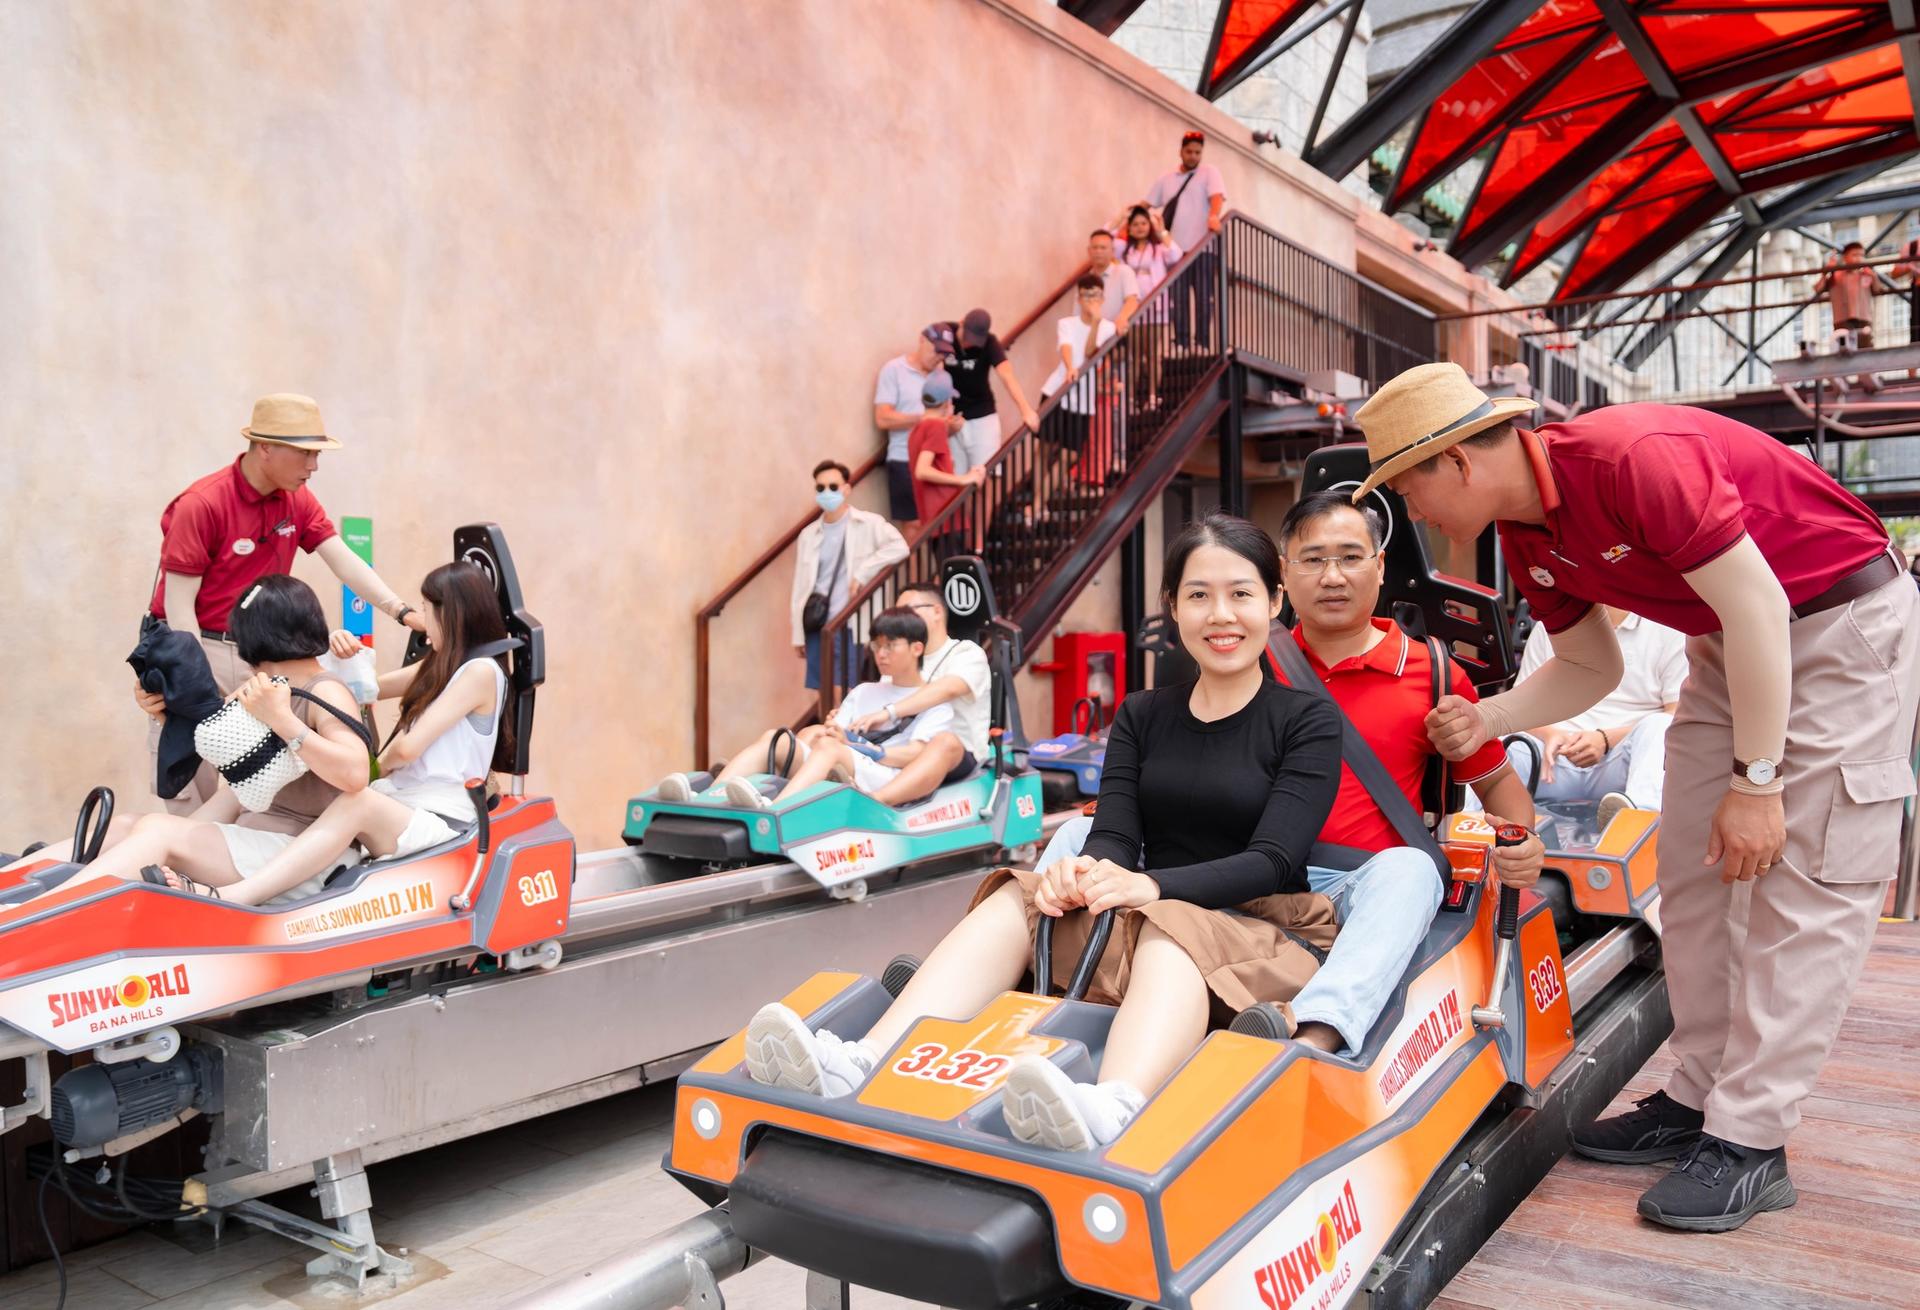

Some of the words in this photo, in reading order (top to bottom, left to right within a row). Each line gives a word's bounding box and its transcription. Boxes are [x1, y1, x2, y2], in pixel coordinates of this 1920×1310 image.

[816, 839, 874, 871] SUNWORLD
[520, 871, 557, 905] 3.11
[48, 963, 190, 1028] SUNWORLD
[1530, 957, 1561, 1011] 3.32
[90, 1022, 108, 1033] BA
[111, 1015, 128, 1026] NA
[130, 1006, 164, 1022] HILLS
[895, 1044, 1011, 1089] 3.32
[1254, 1178, 1361, 1310] SUNWORLD
[1330, 1261, 1351, 1299] HILLS
